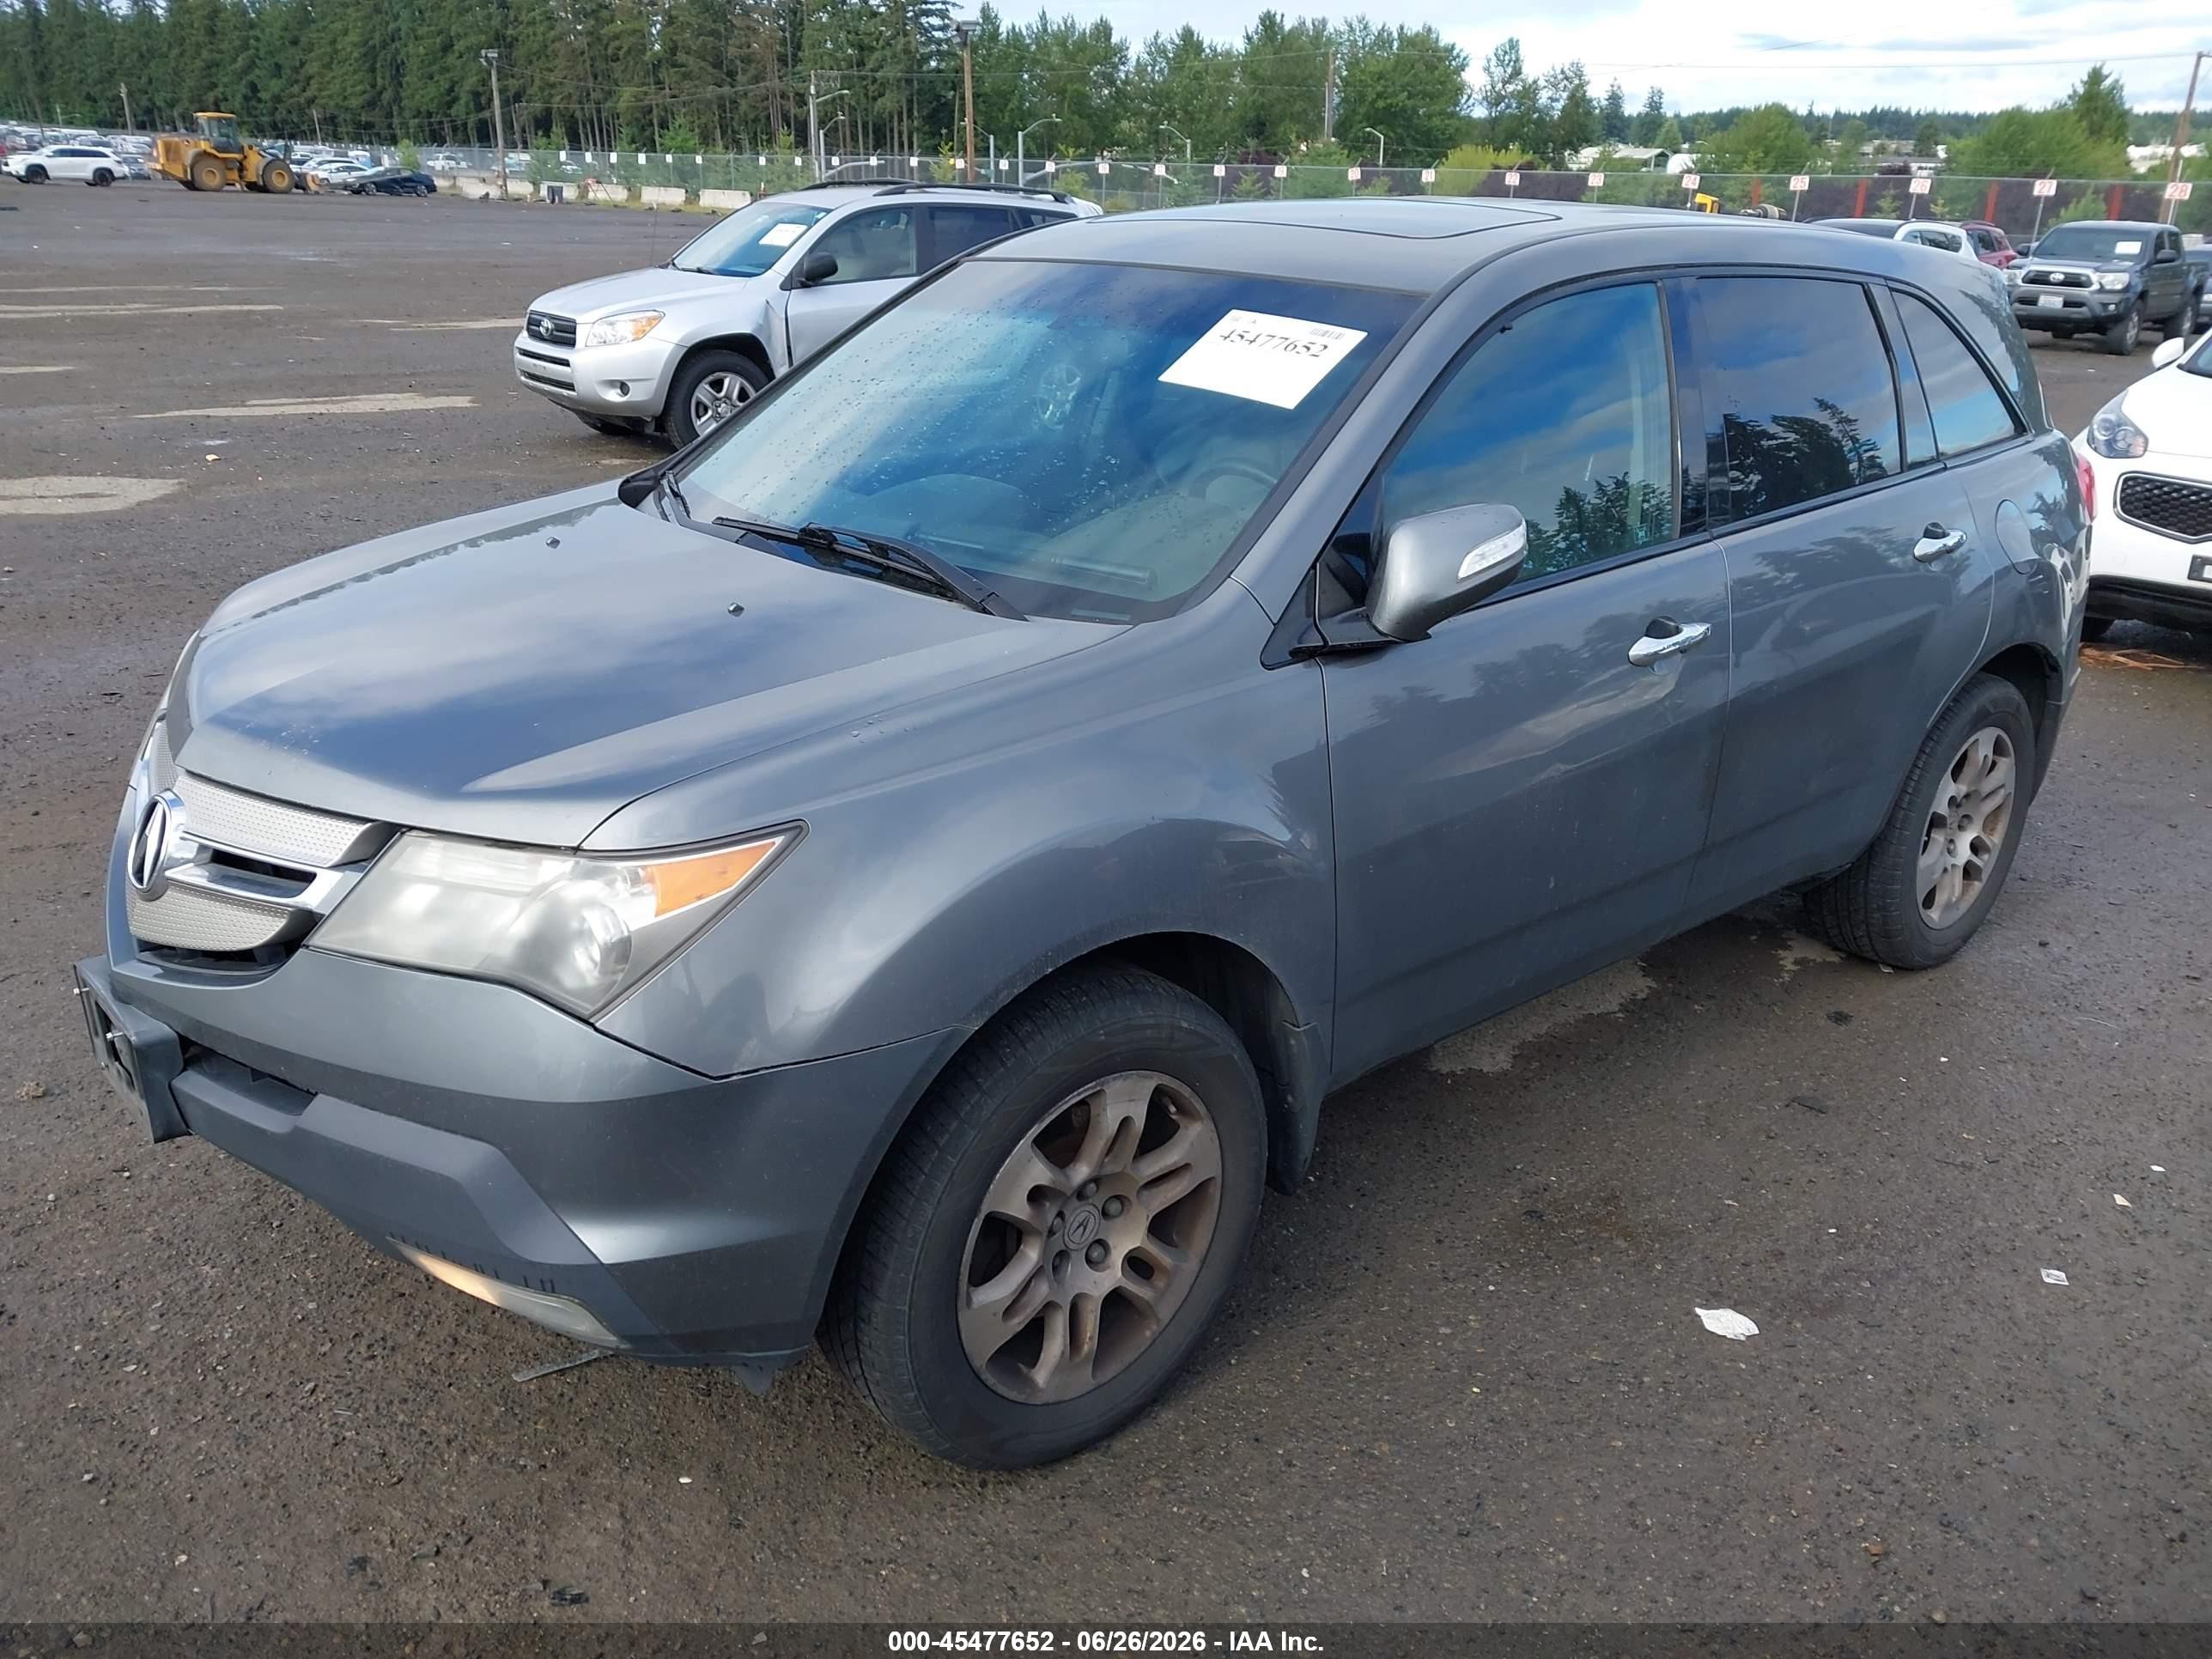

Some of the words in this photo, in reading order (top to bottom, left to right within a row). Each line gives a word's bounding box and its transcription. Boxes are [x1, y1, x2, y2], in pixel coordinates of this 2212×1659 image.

[1507, 173, 1519, 184] 22
[1589, 173, 1603, 185] 23
[1684, 174, 1698, 186] 24
[1792, 177, 1808, 189] 25
[1911, 179, 1929, 192] 26
[2038, 180, 2055, 194] 27
[2167, 183, 2189, 198] 28
[1219, 329, 1328, 357] 45477652
